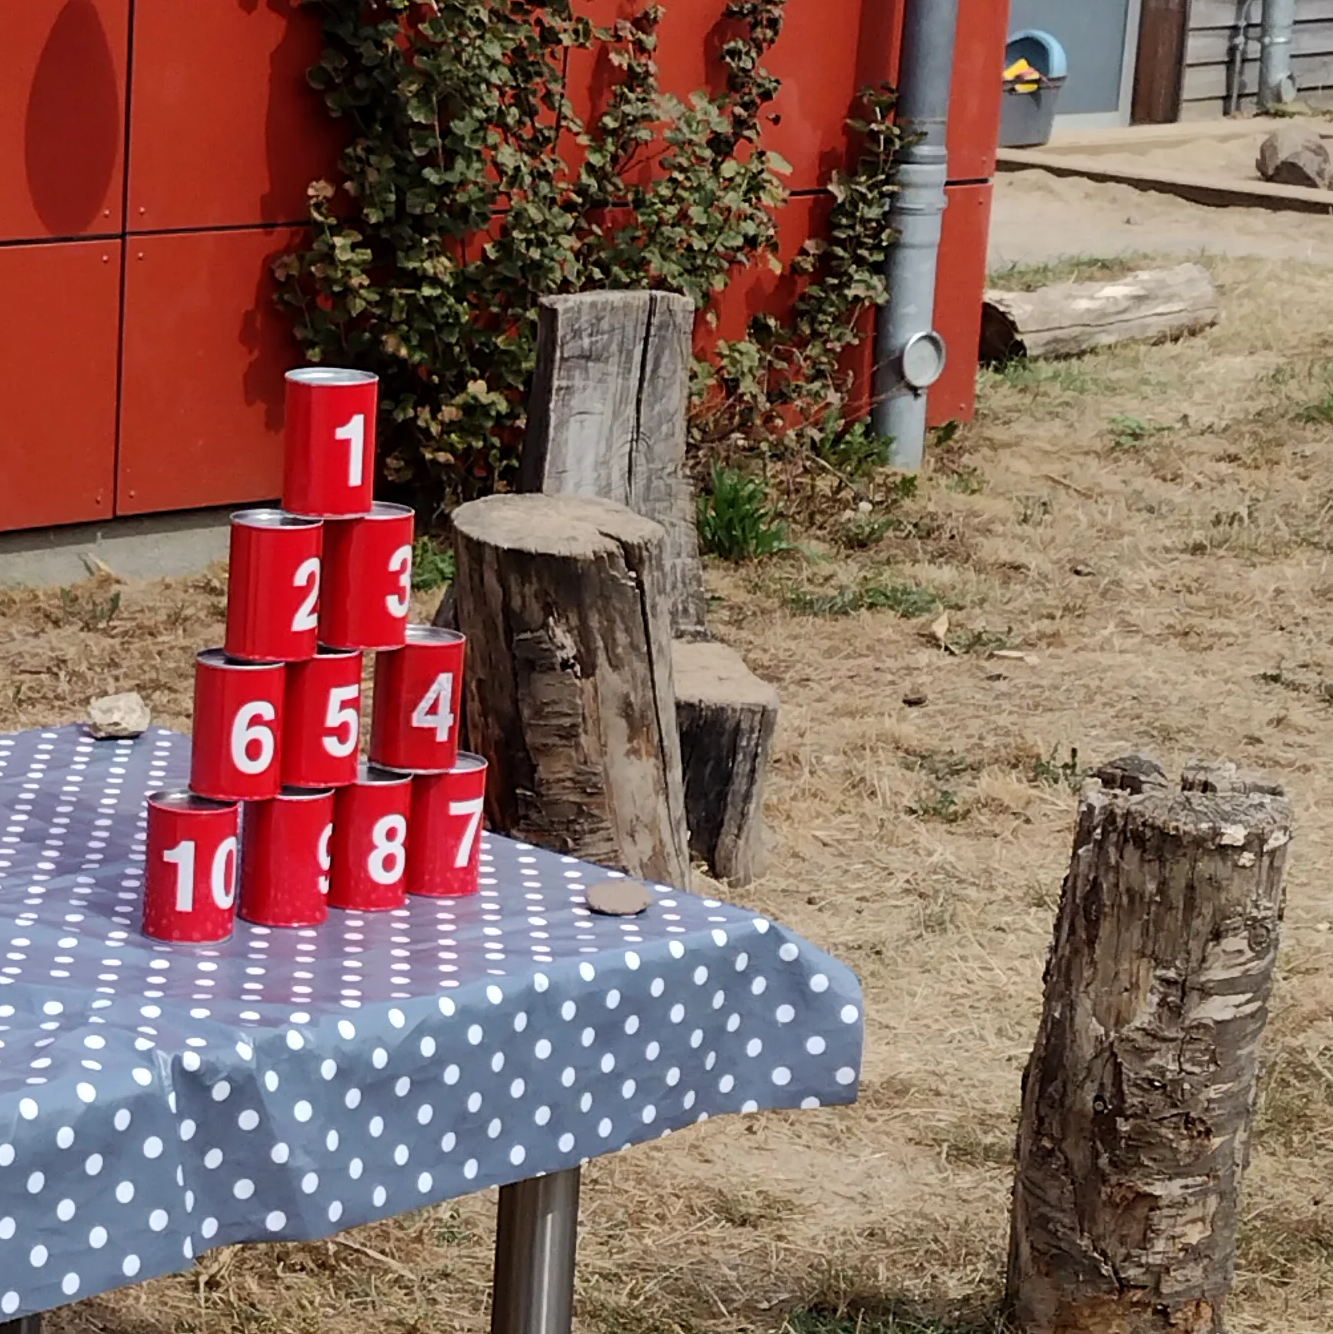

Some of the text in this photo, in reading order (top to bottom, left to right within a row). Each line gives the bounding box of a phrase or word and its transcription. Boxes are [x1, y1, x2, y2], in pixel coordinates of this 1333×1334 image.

[335, 413, 365, 487] 1
[291, 557, 320, 632] 2
[385, 544, 412, 619] 3
[230, 700, 276, 775] 6
[322, 683, 359, 758] 5
[412, 672, 455, 743] 4
[367, 813, 407, 885] 8
[448, 796, 484, 868] 7
[163, 836, 236, 912] 10
